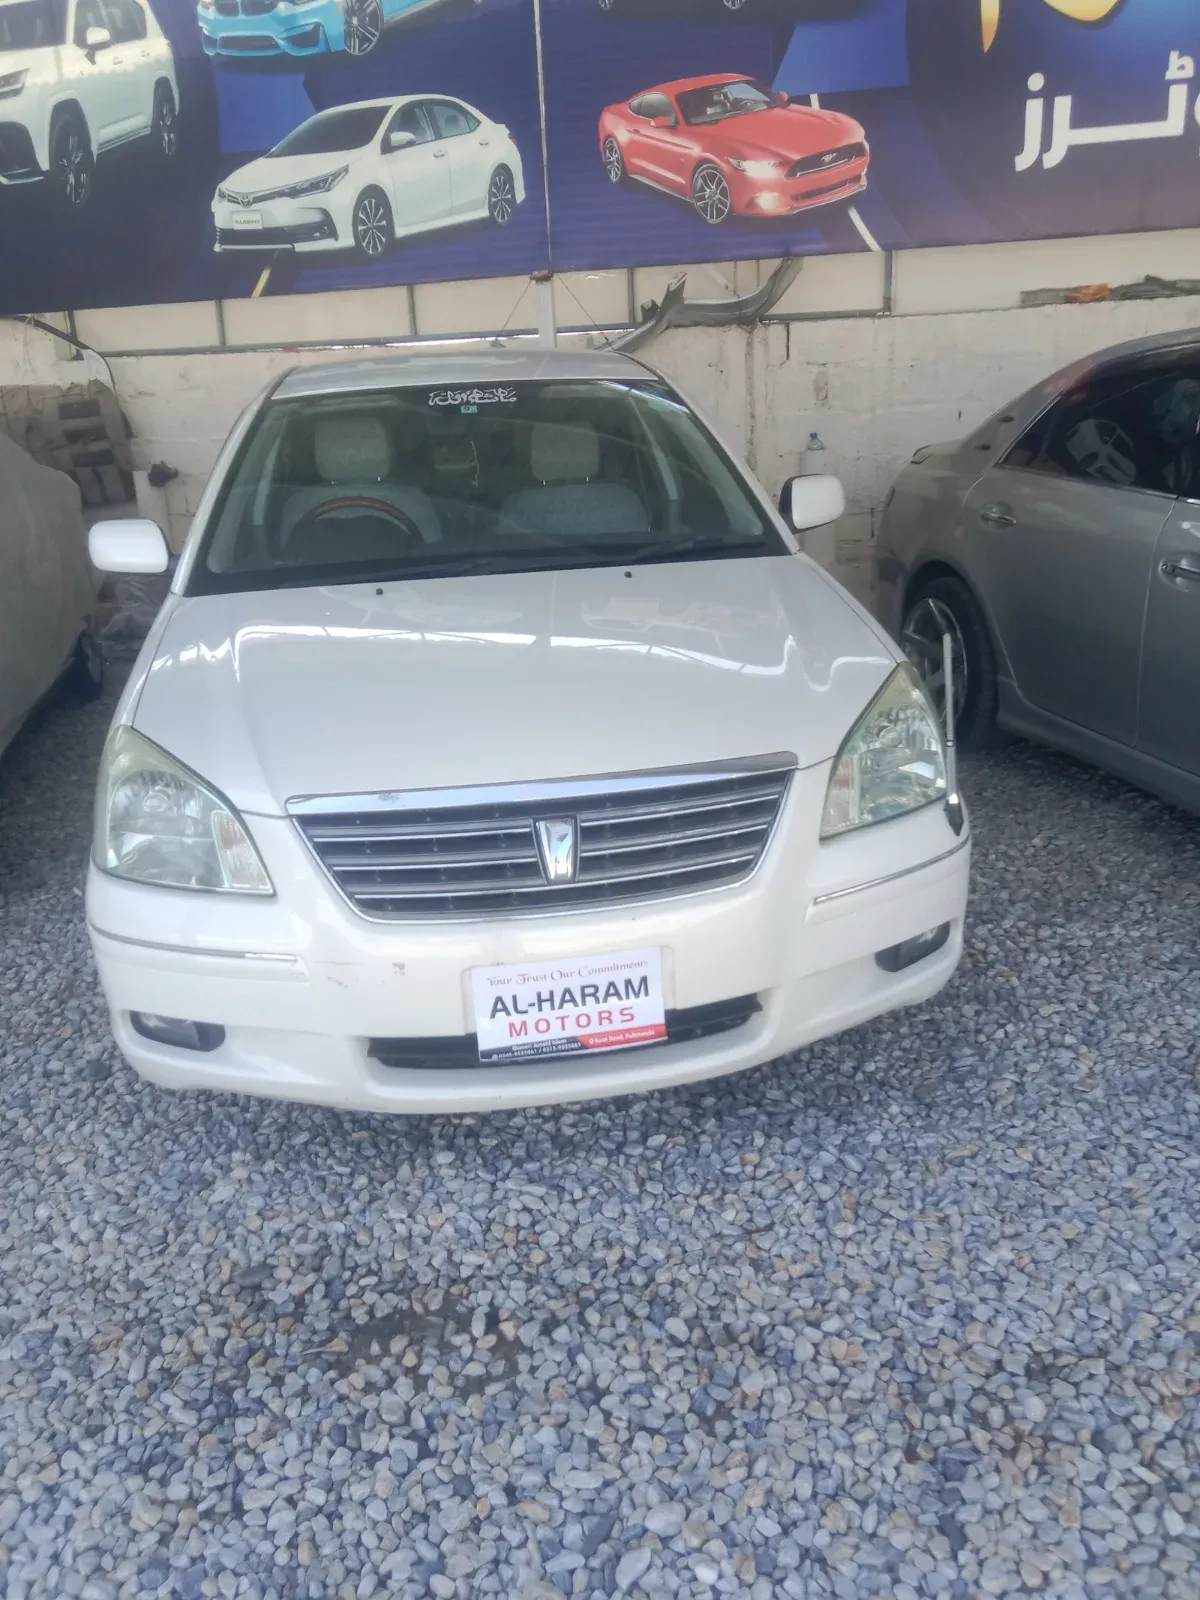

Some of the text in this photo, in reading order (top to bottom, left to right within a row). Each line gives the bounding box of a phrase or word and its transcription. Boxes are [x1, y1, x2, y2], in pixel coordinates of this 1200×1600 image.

[487, 976, 513, 987] Your
[516, 973, 547, 984] Trust
[550, 969, 576, 981] Our
[489, 975, 650, 1020] AL-HARAM
[508, 1007, 636, 1038] MOTORS
